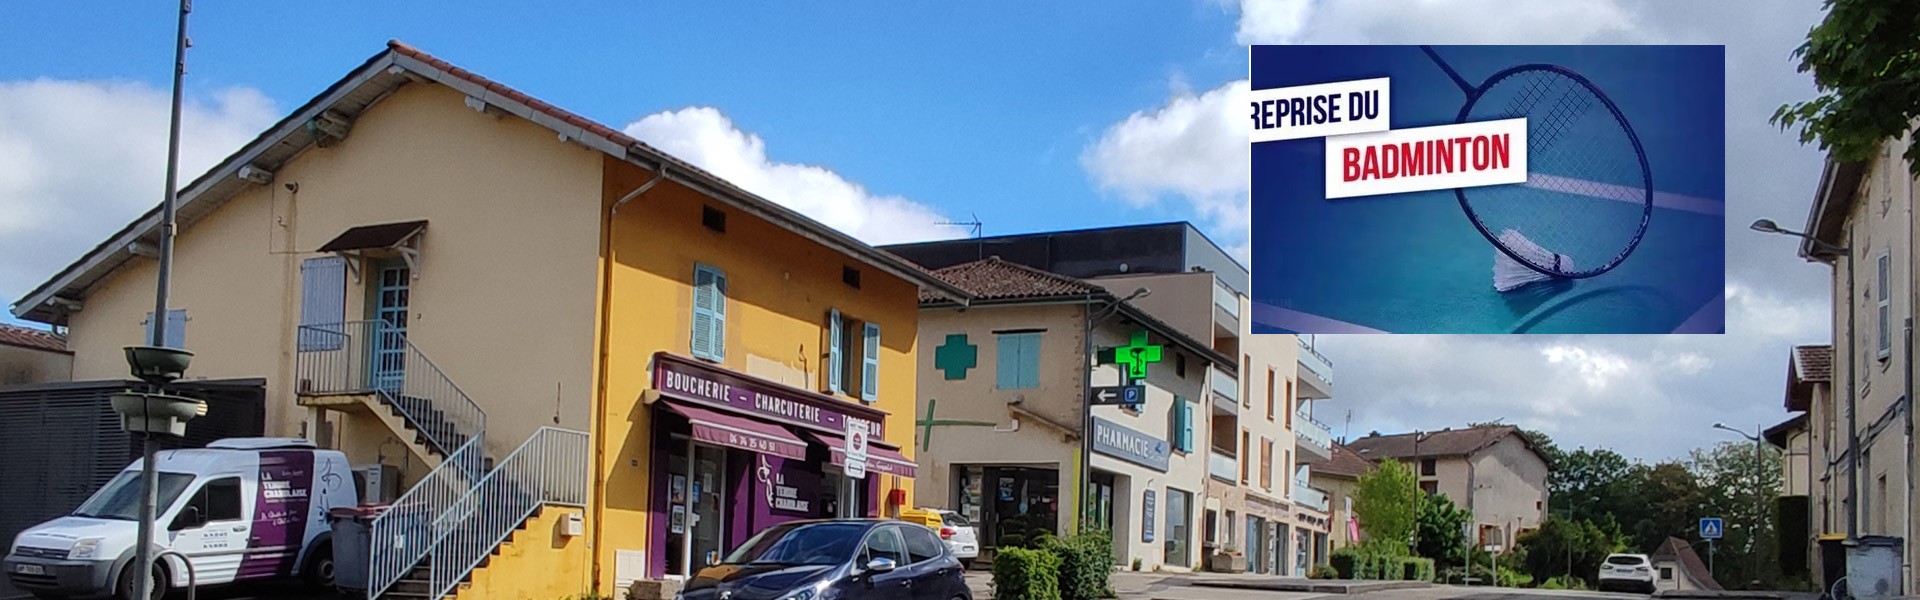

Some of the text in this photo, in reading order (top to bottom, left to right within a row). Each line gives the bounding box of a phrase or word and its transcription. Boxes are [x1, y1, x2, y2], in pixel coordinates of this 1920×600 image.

[666, 370, 731, 402] BOUCHERIE
[755, 393, 820, 423] CHARCUTERIE
[1097, 424, 1149, 459] PHARMACIE
